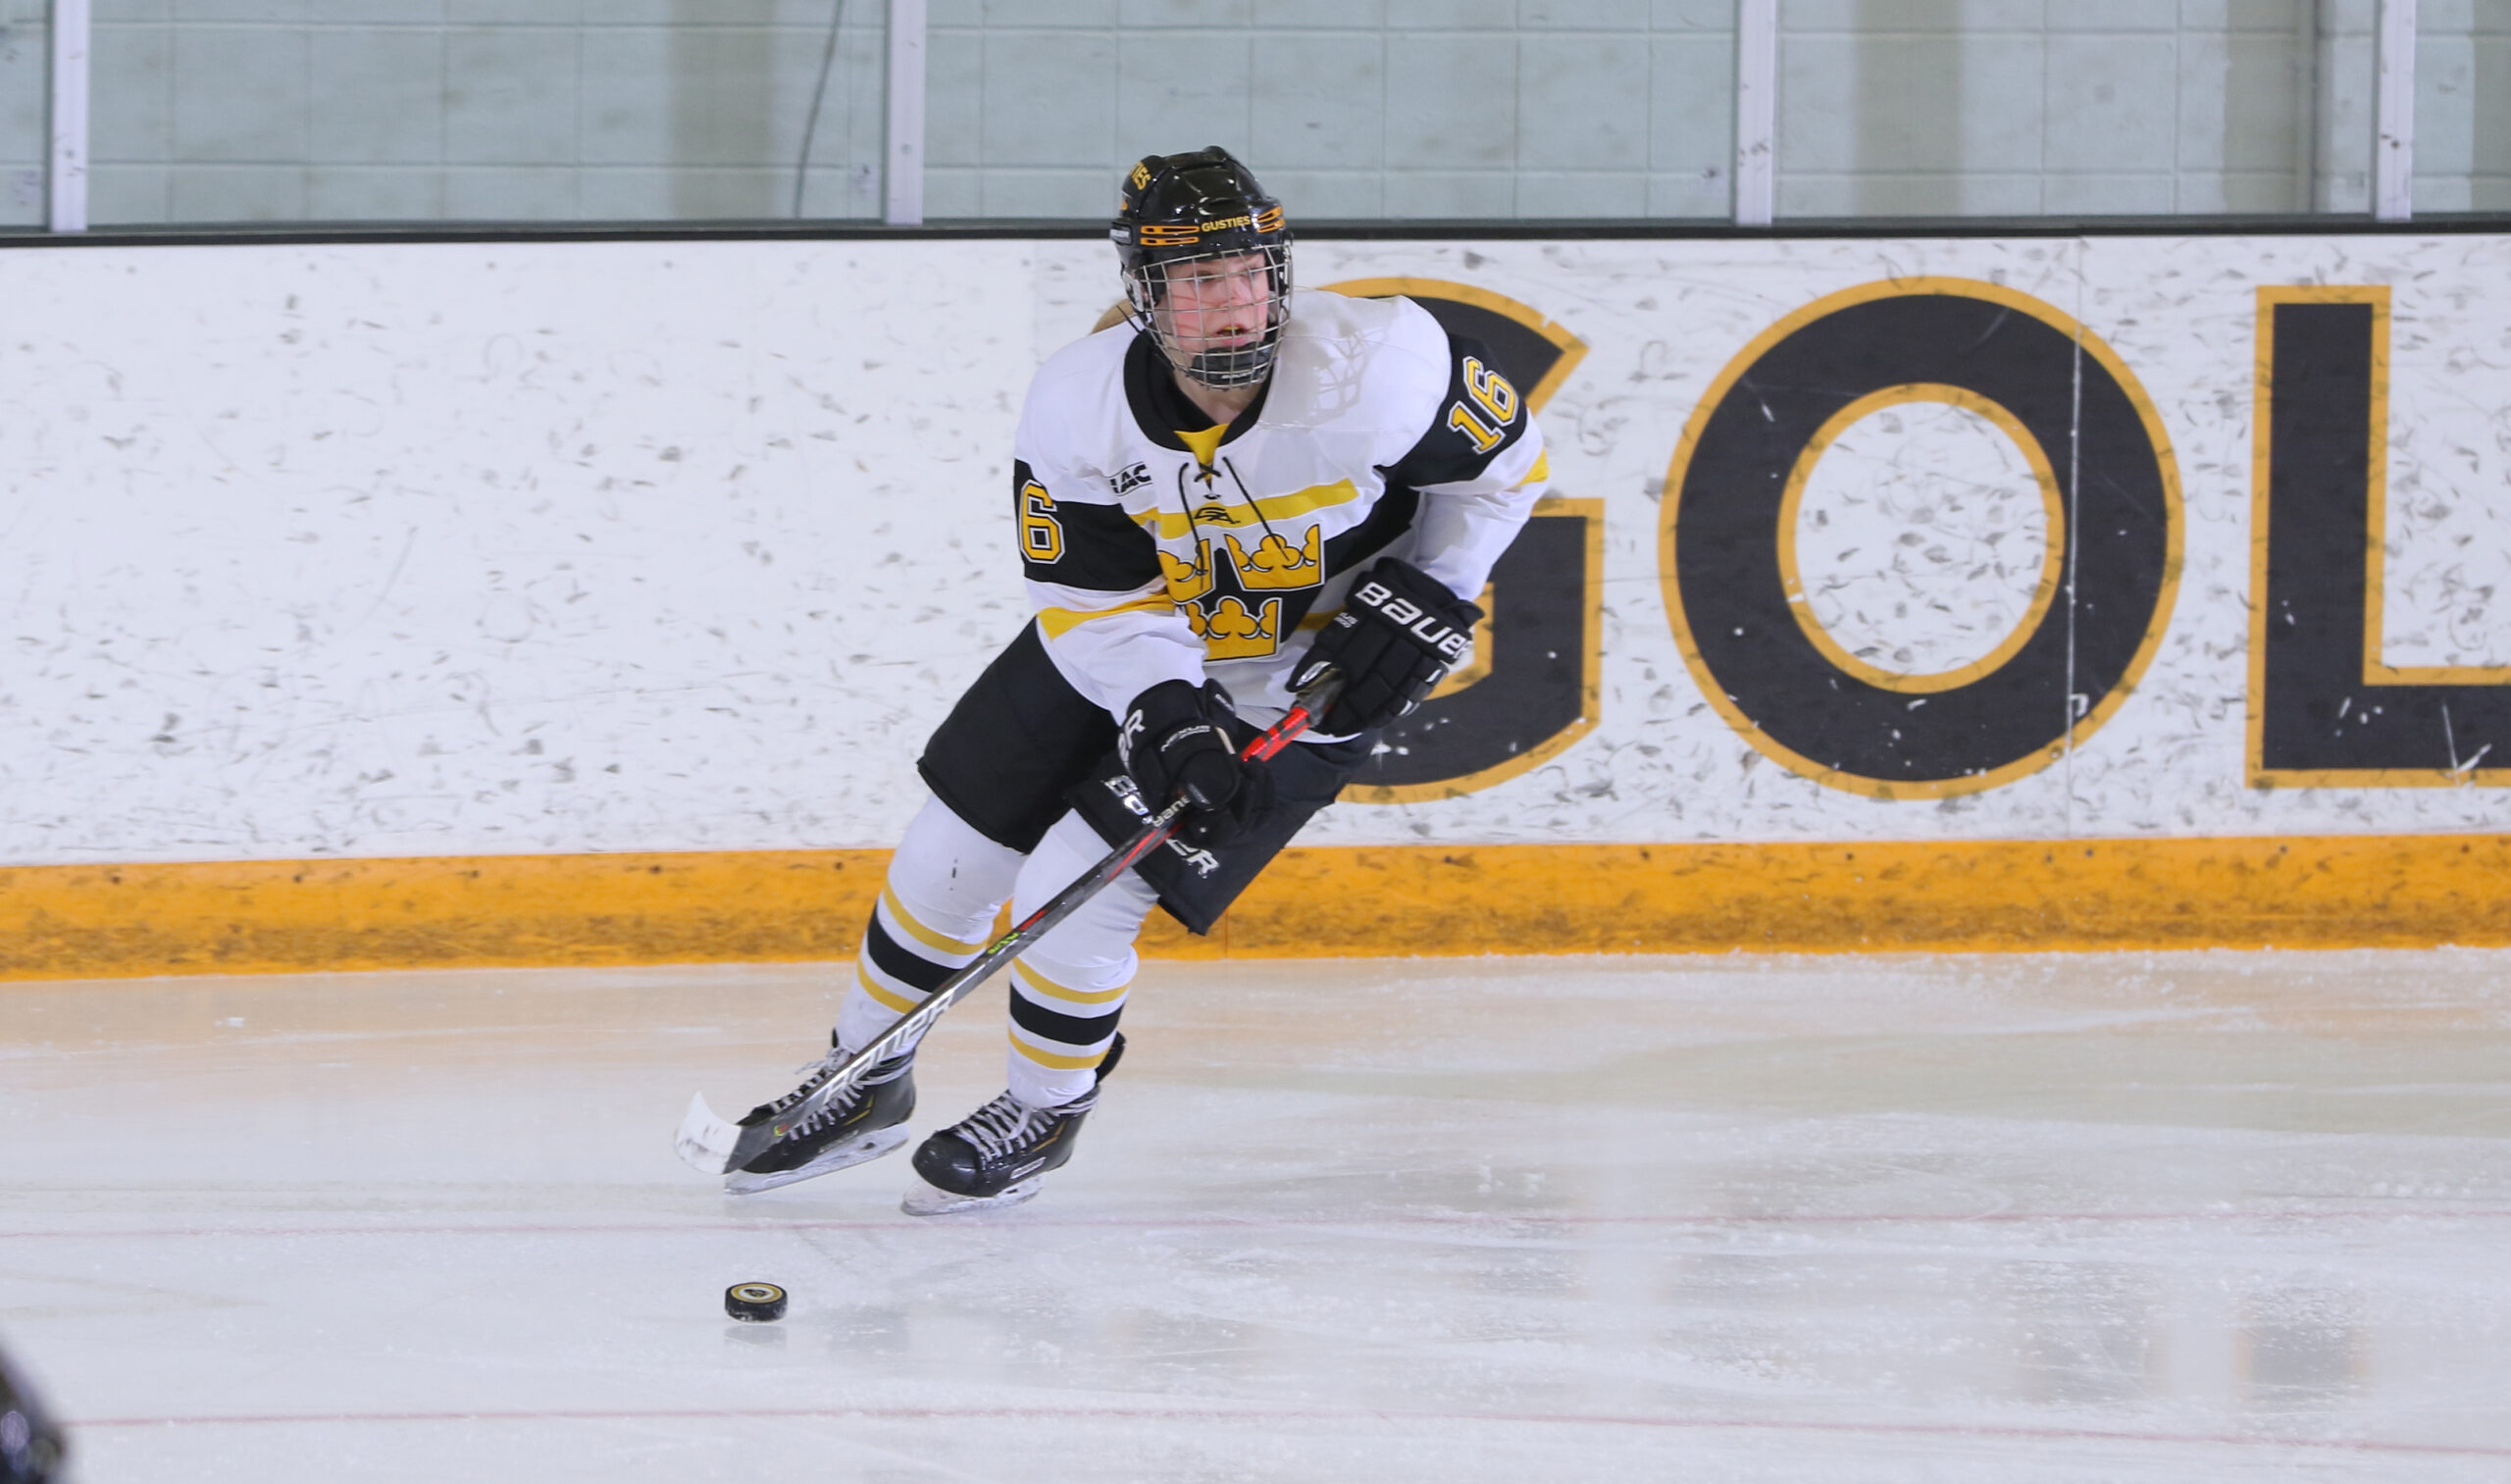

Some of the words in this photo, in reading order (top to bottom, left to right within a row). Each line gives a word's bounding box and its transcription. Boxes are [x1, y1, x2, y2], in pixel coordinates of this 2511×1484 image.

[1202, 215, 1251, 232] GUSTIES
[1447, 356, 1518, 454] 16
[1109, 463, 1152, 493] IAC
[1019, 479, 1065, 565] 6
